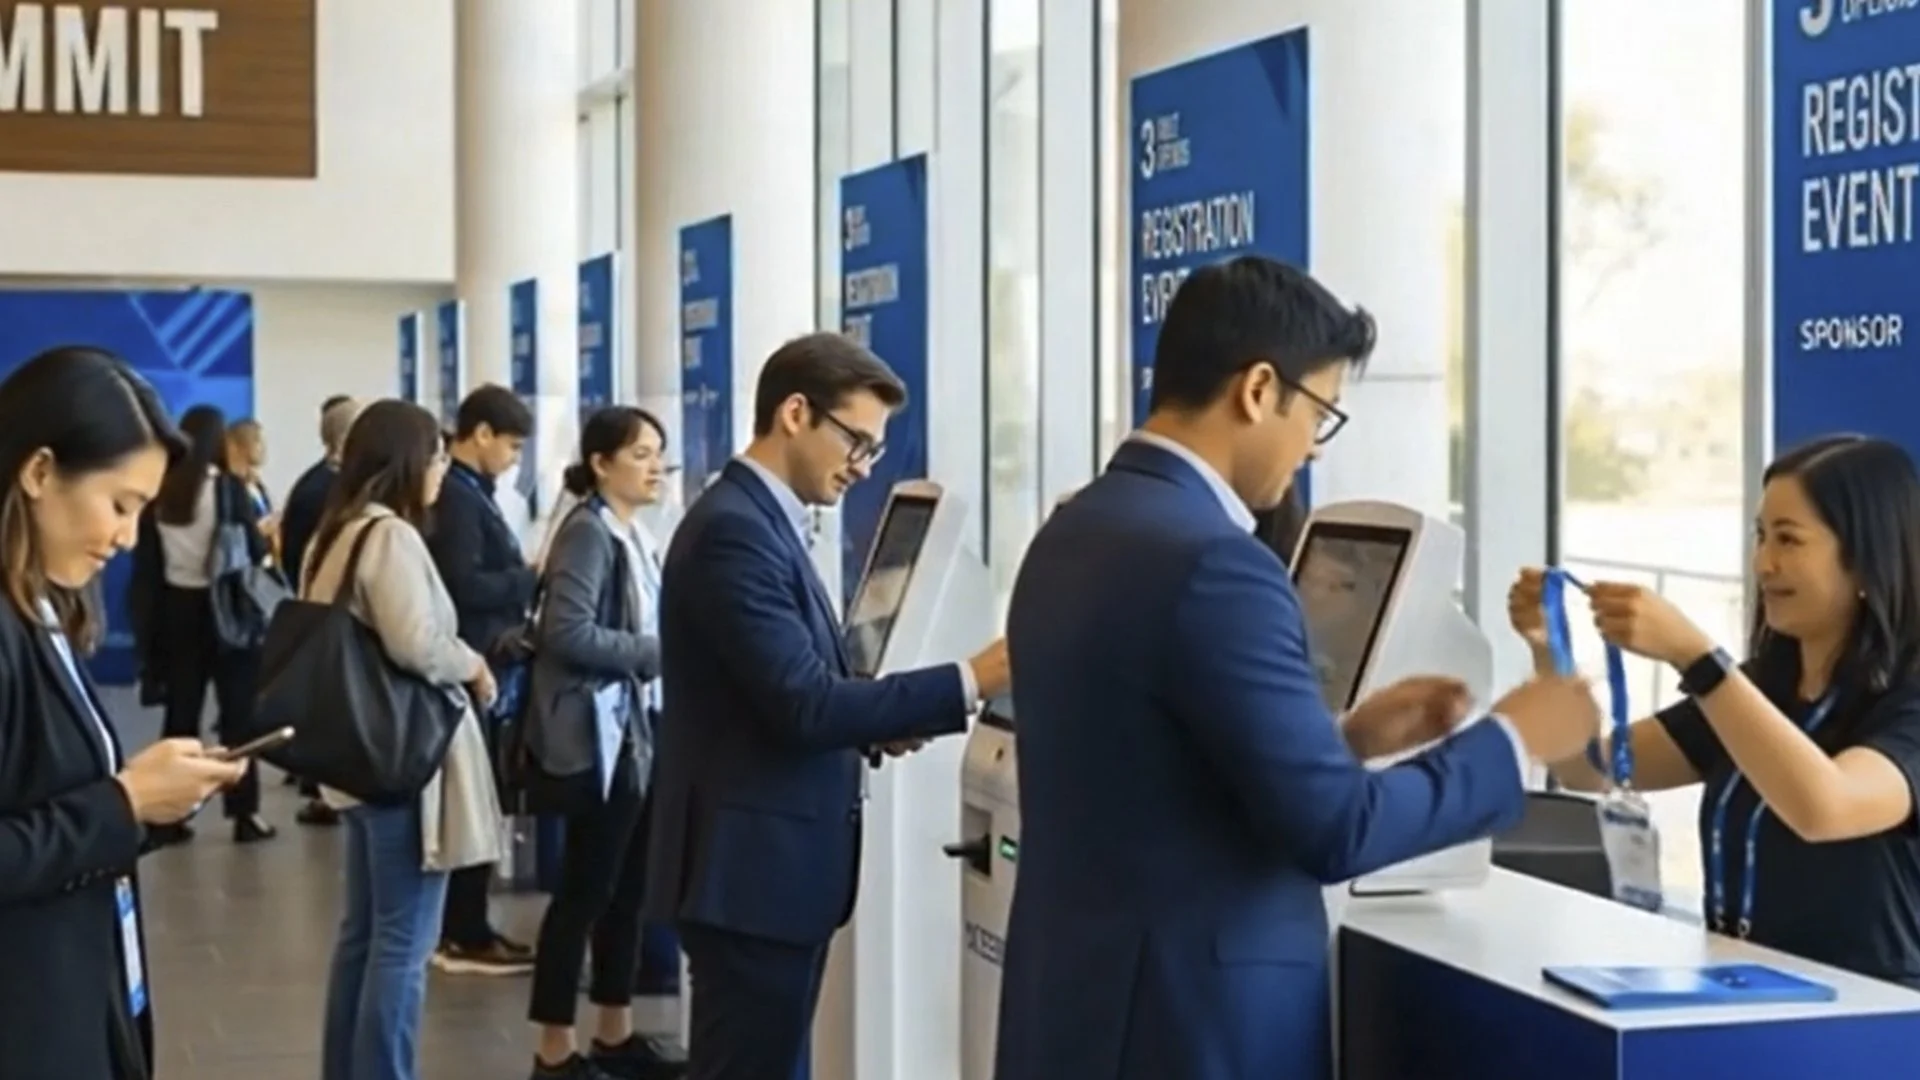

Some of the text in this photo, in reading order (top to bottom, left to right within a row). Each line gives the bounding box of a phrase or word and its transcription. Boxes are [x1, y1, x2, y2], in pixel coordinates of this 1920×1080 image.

[0, 2, 218, 117] MMIT
[1141, 119, 1155, 179] 3
[1803, 63, 1920, 157] REGIST
[1803, 164, 1919, 252] EVENT
[1800, 314, 1903, 351] SPONSOR
